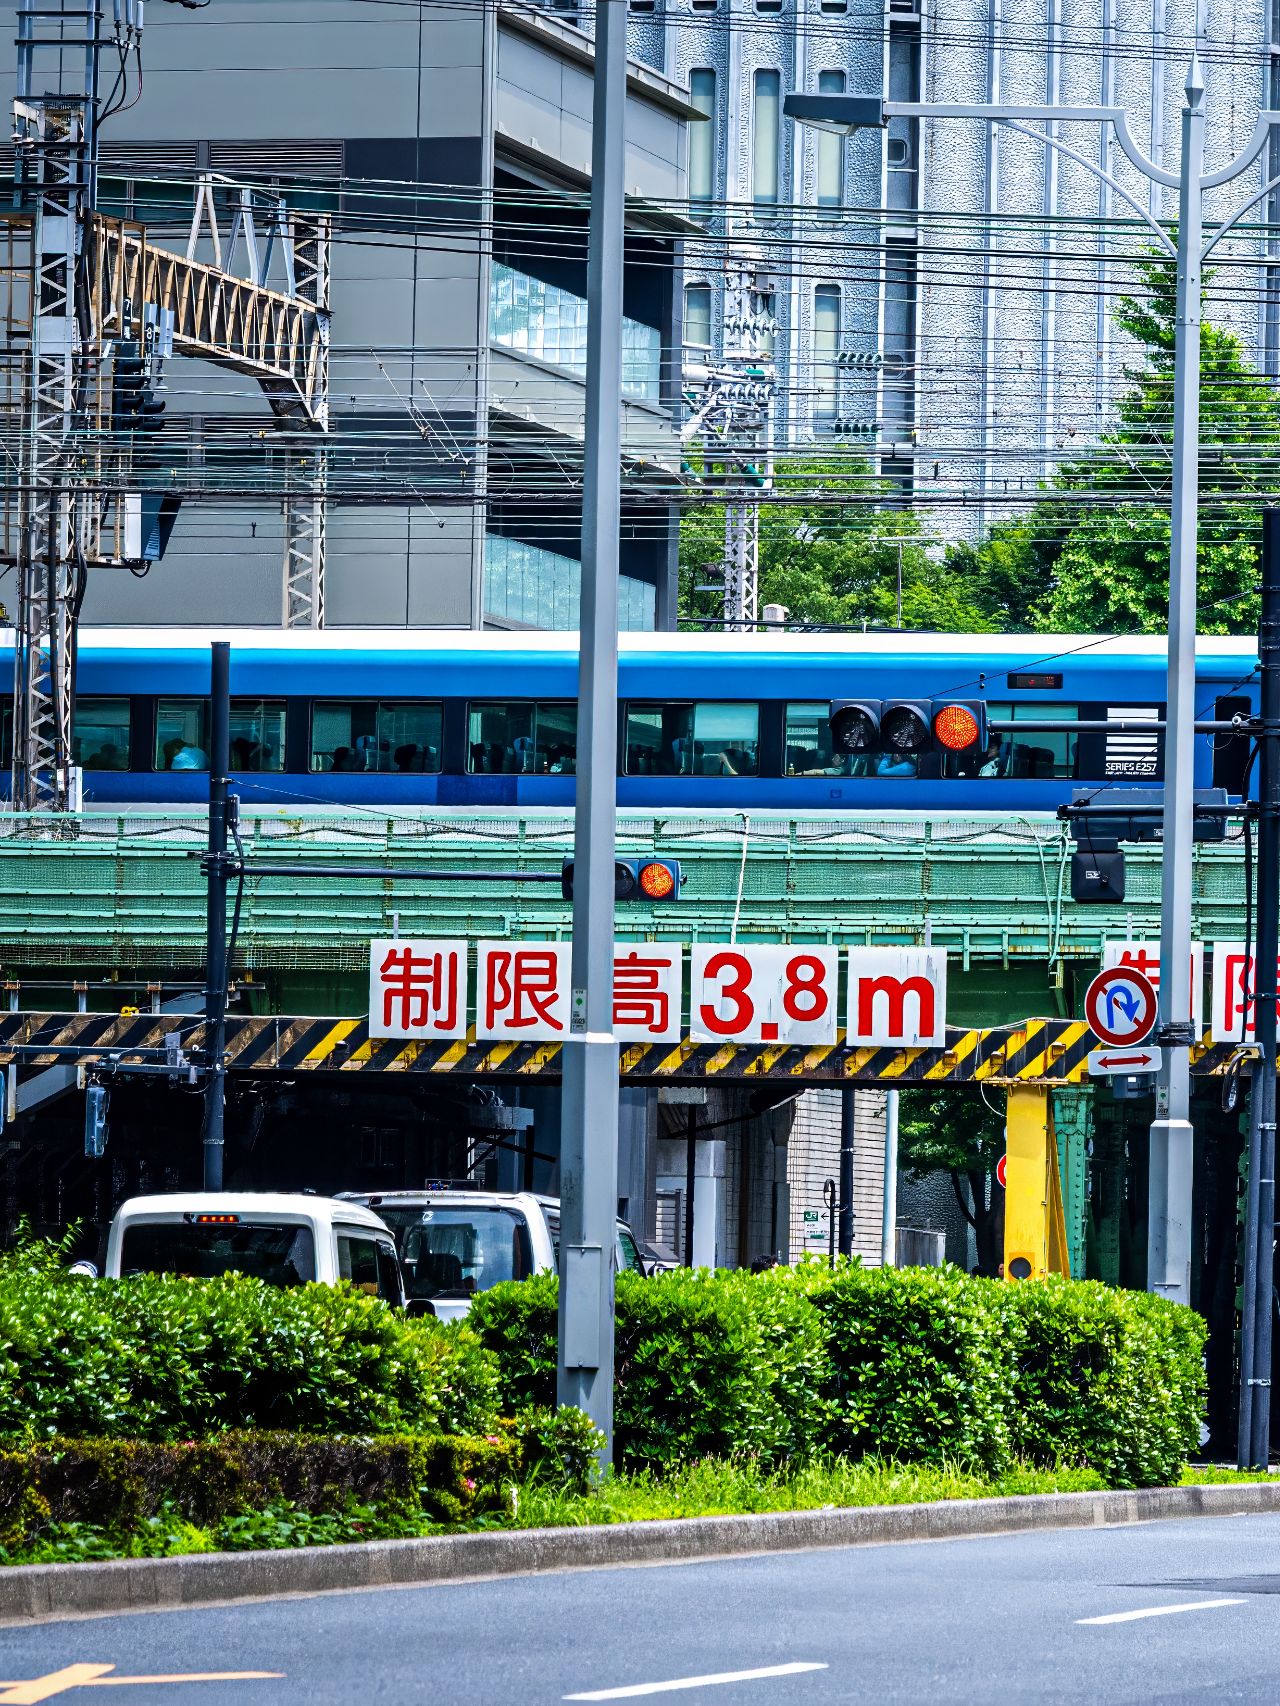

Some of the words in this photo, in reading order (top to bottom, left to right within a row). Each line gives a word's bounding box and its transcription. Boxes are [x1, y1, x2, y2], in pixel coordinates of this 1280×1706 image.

[1105, 762, 1135, 771] SERIES
[1136, 762, 1157, 772] E257
[805, 1211, 818, 1220] JR
